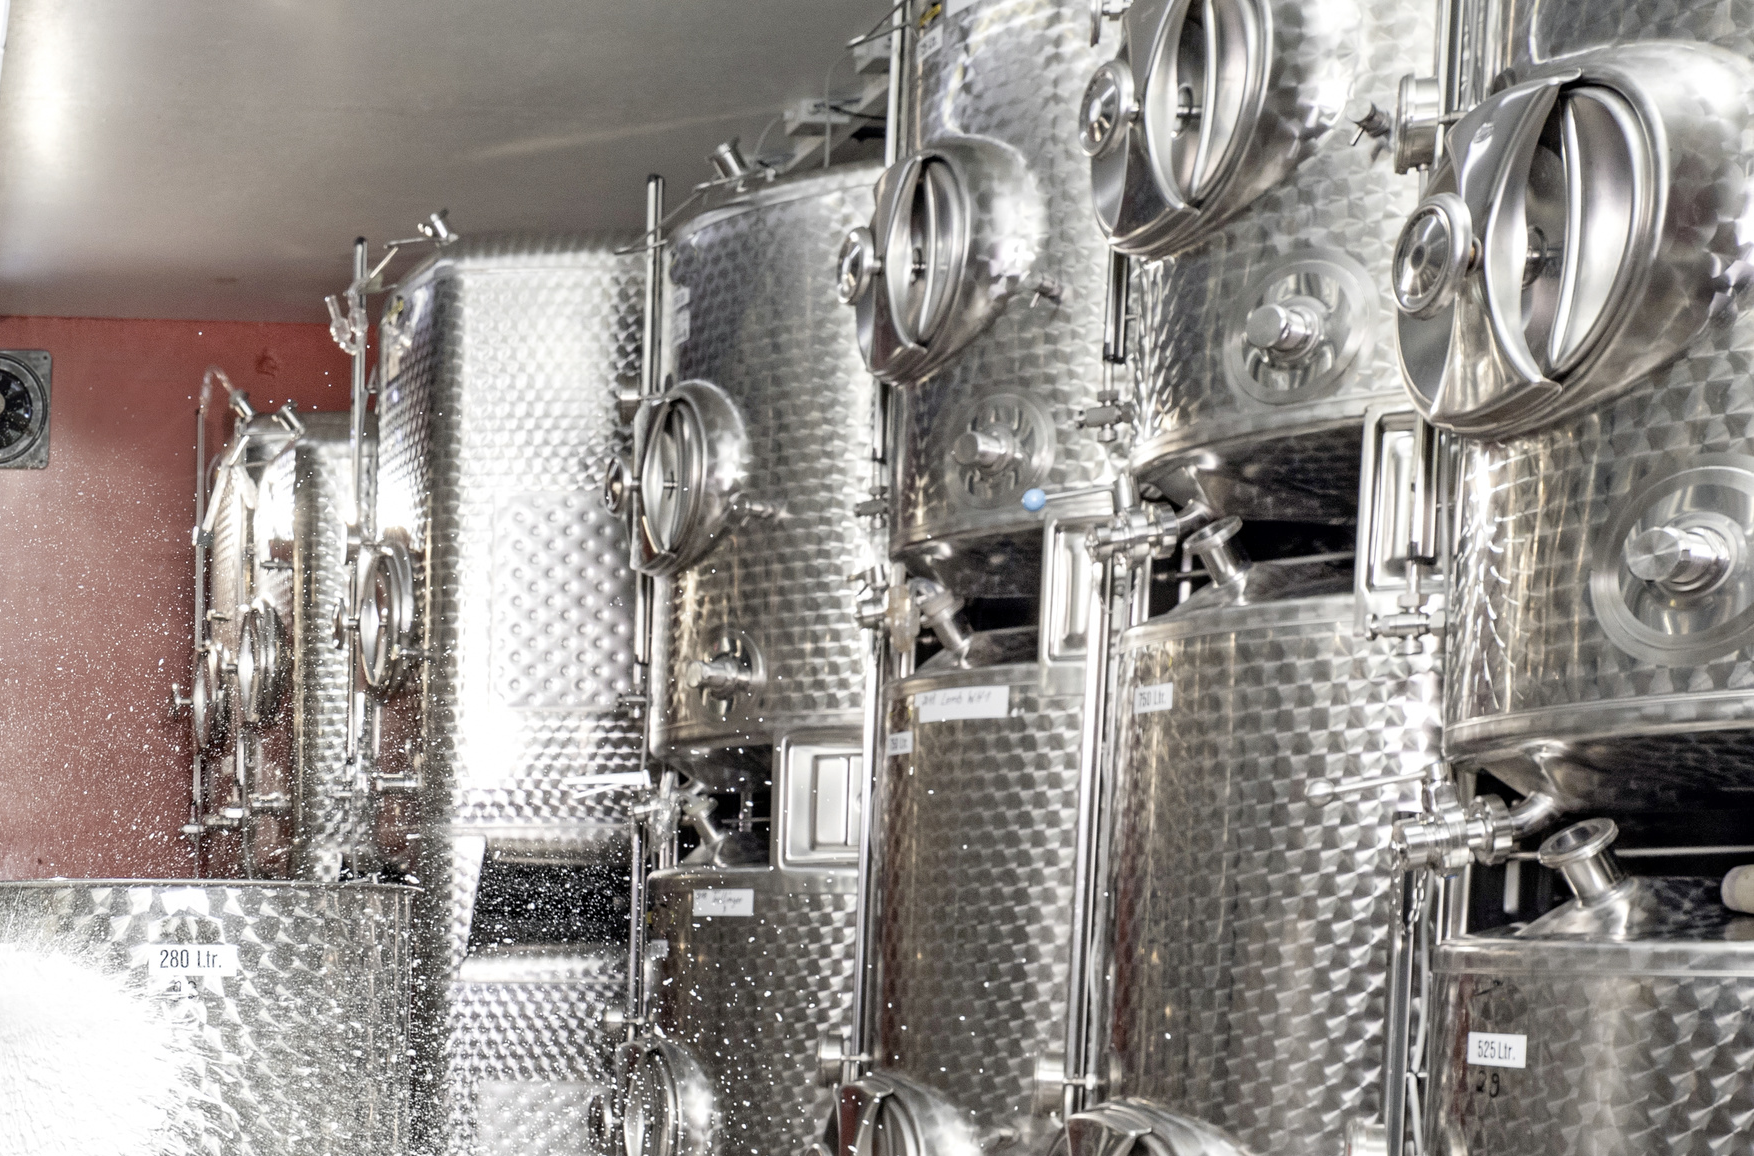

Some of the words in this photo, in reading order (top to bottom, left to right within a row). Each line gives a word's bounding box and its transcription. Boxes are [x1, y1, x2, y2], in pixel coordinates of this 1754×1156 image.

[159, 949, 189, 968] 280
[197, 950, 222, 968] Ltr.
[1478, 1040, 1496, 1059] 525
[1498, 1041, 1516, 1061] Ltr.
